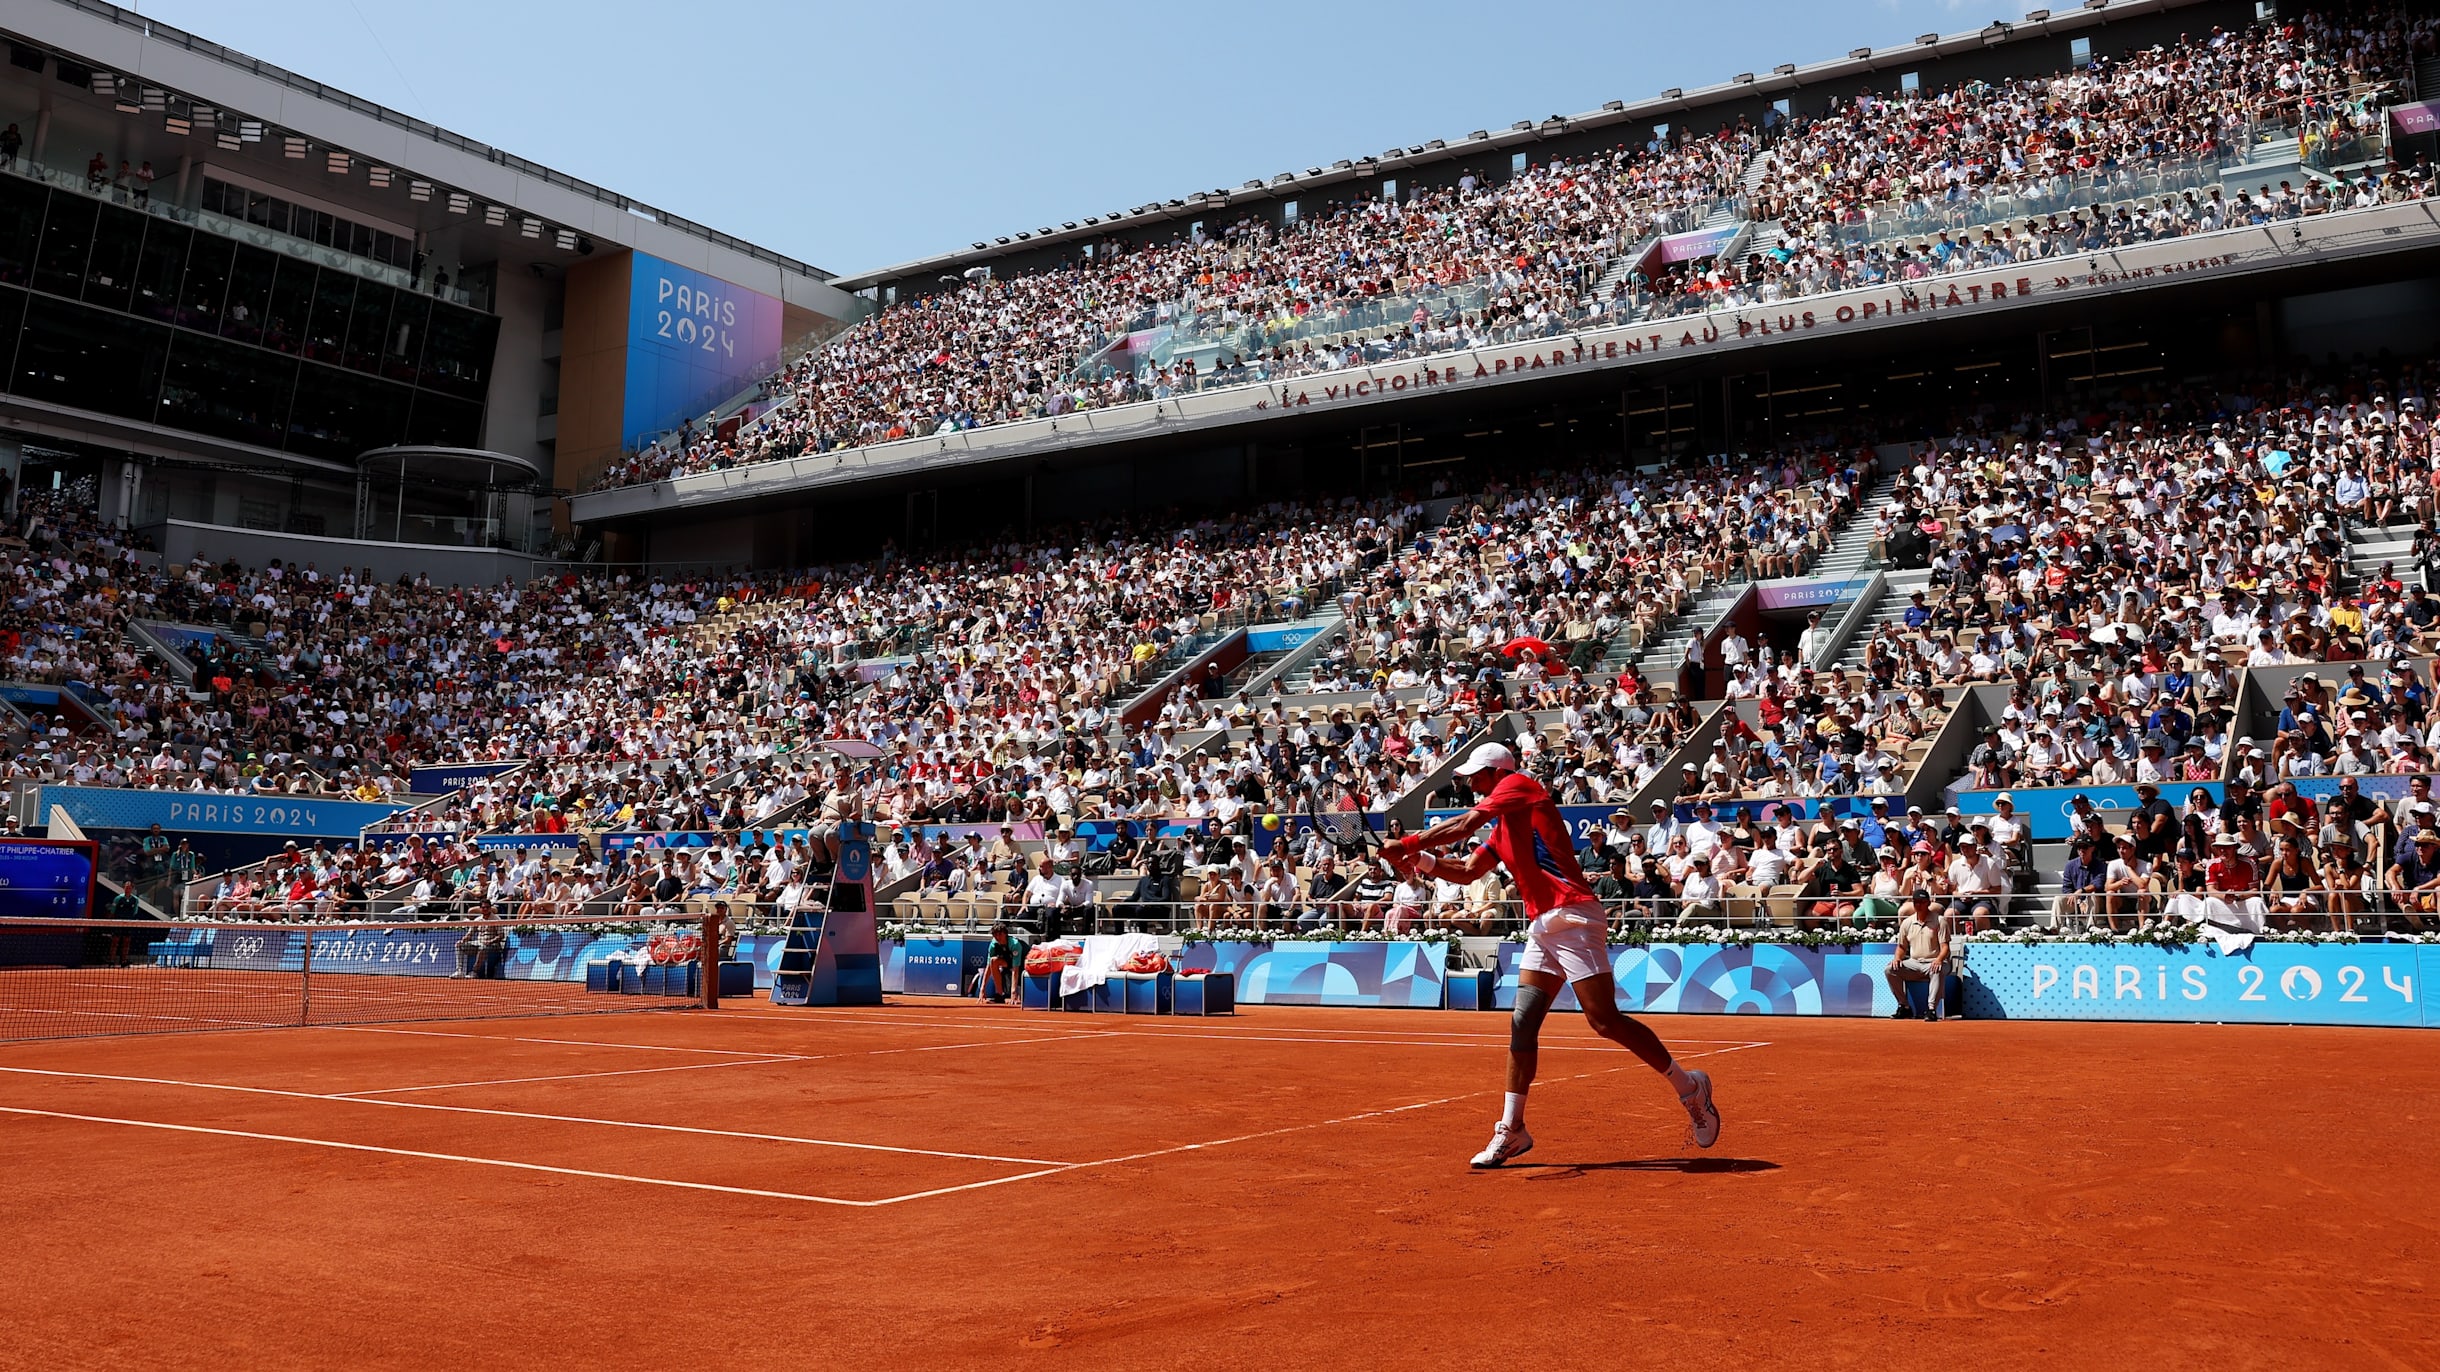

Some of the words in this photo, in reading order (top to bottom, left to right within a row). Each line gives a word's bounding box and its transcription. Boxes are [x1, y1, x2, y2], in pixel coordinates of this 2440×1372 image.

[2087, 267, 2155, 286] ROLAND
[2162, 255, 2232, 274] GARROS
[657, 310, 734, 358] 2024
[1281, 391, 1310, 408] LA
[1324, 366, 1457, 401] VICTOIRE
[1473, 334, 1663, 379] APPARTIENT
[1679, 325, 1720, 347] AU
[1738, 310, 1816, 338] PLUS
[1835, 277, 2032, 323] OPINIÂTRE
[254, 806, 317, 827] 2024
[6, 846, 75, 856] PHILIPPE-CHATRIER
[380, 942, 440, 964] 2024
[934, 955, 958, 965] 2024
[2032, 965, 2208, 1001] PARIS
[2237, 965, 2414, 1003] 2024
